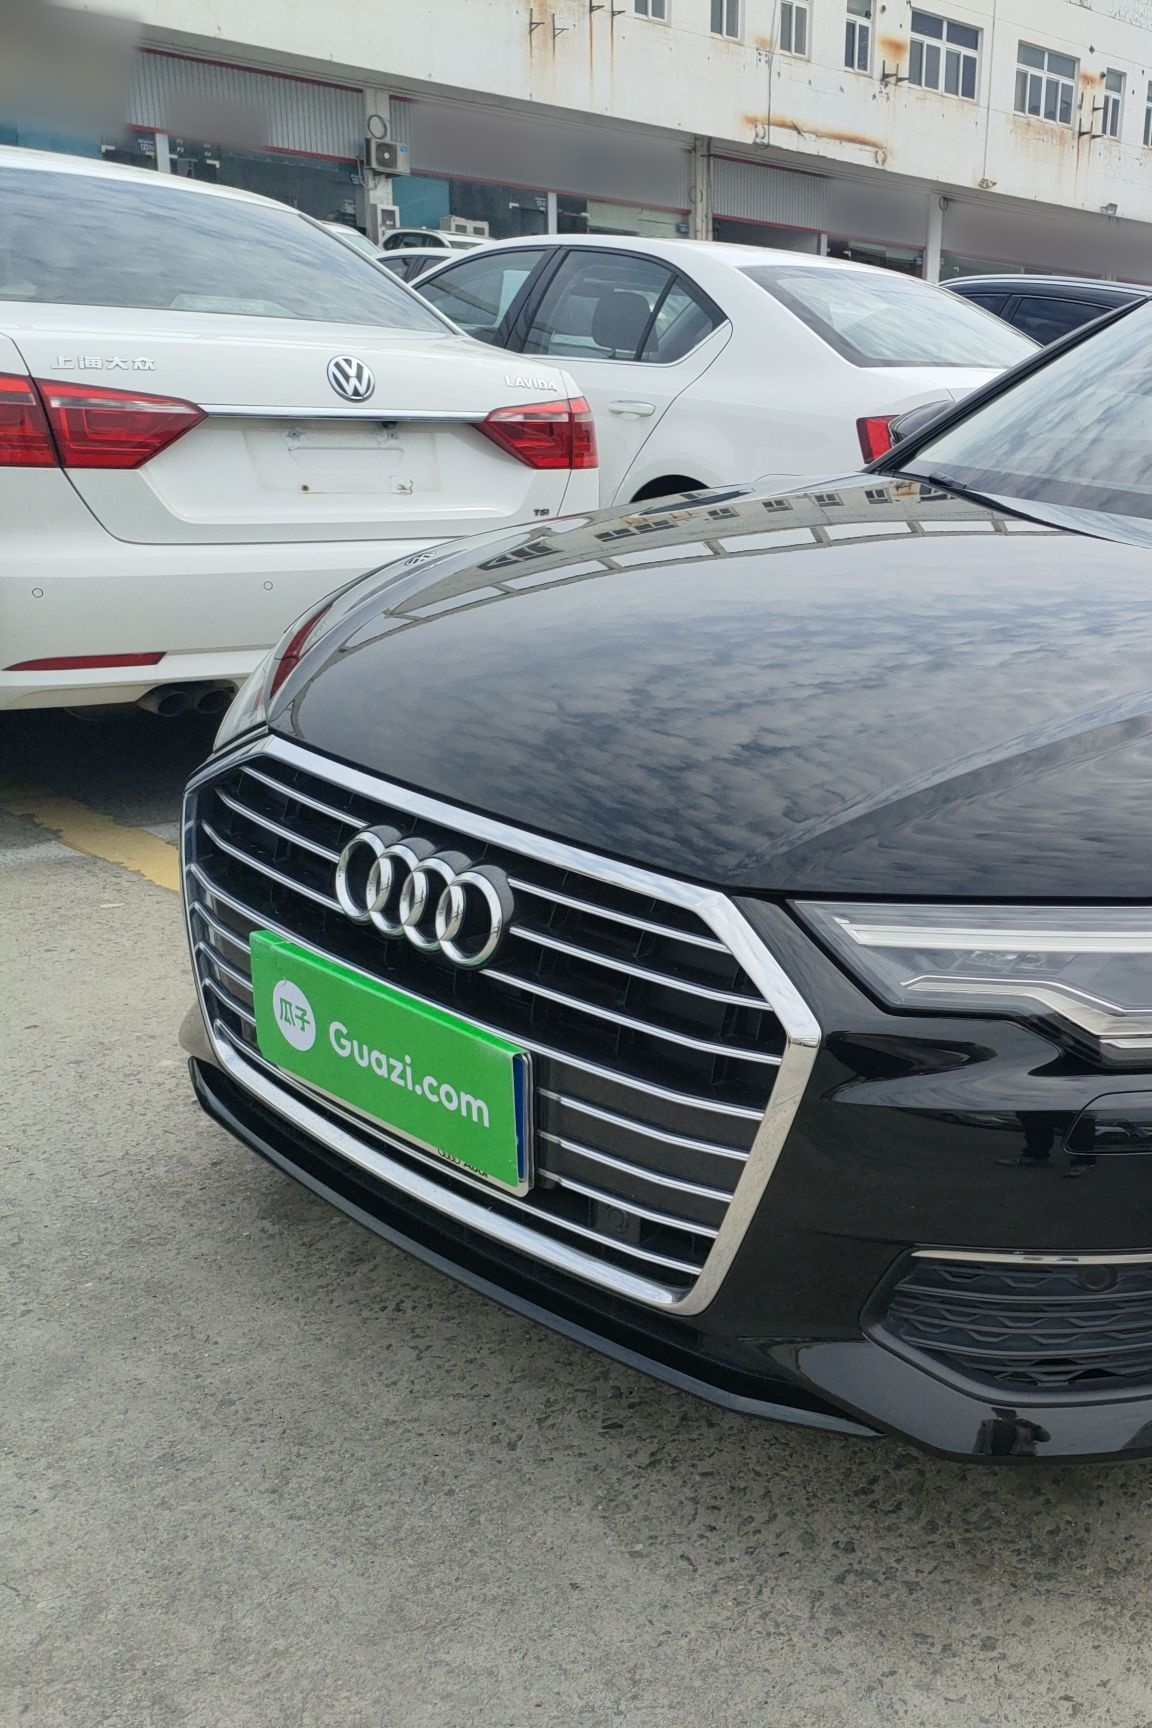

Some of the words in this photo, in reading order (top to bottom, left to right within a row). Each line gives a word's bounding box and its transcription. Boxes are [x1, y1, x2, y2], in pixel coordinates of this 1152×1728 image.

[50, 355, 156, 371] 上海大众
[504, 375, 558, 392] LAVIDA
[278, 996, 311, 1033] 瓜子
[328, 1020, 491, 1129] Guazi.com
